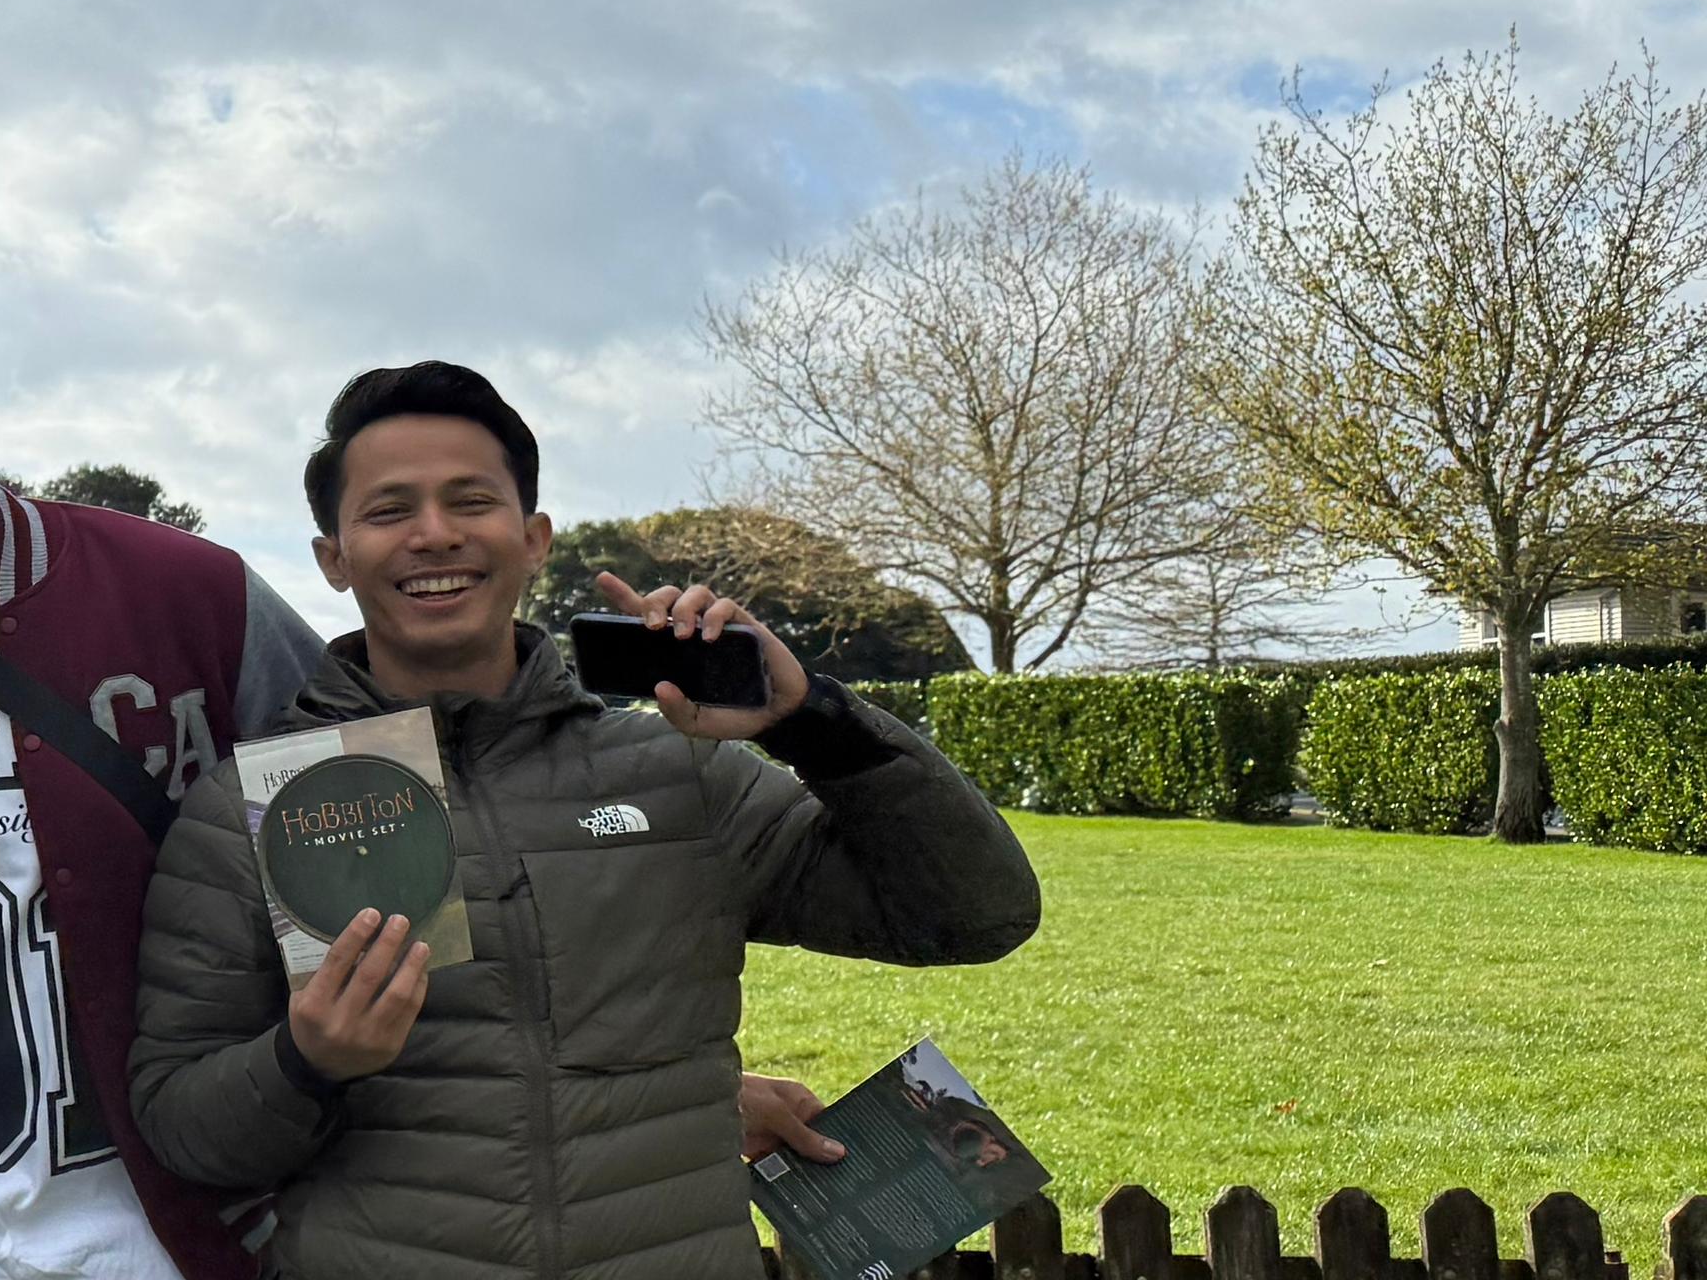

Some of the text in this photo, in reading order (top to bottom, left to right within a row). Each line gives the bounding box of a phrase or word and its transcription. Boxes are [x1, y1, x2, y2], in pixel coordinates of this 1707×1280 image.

[281, 787, 415, 846] HOBBITON
[314, 822, 396, 847] MOVIE SET
